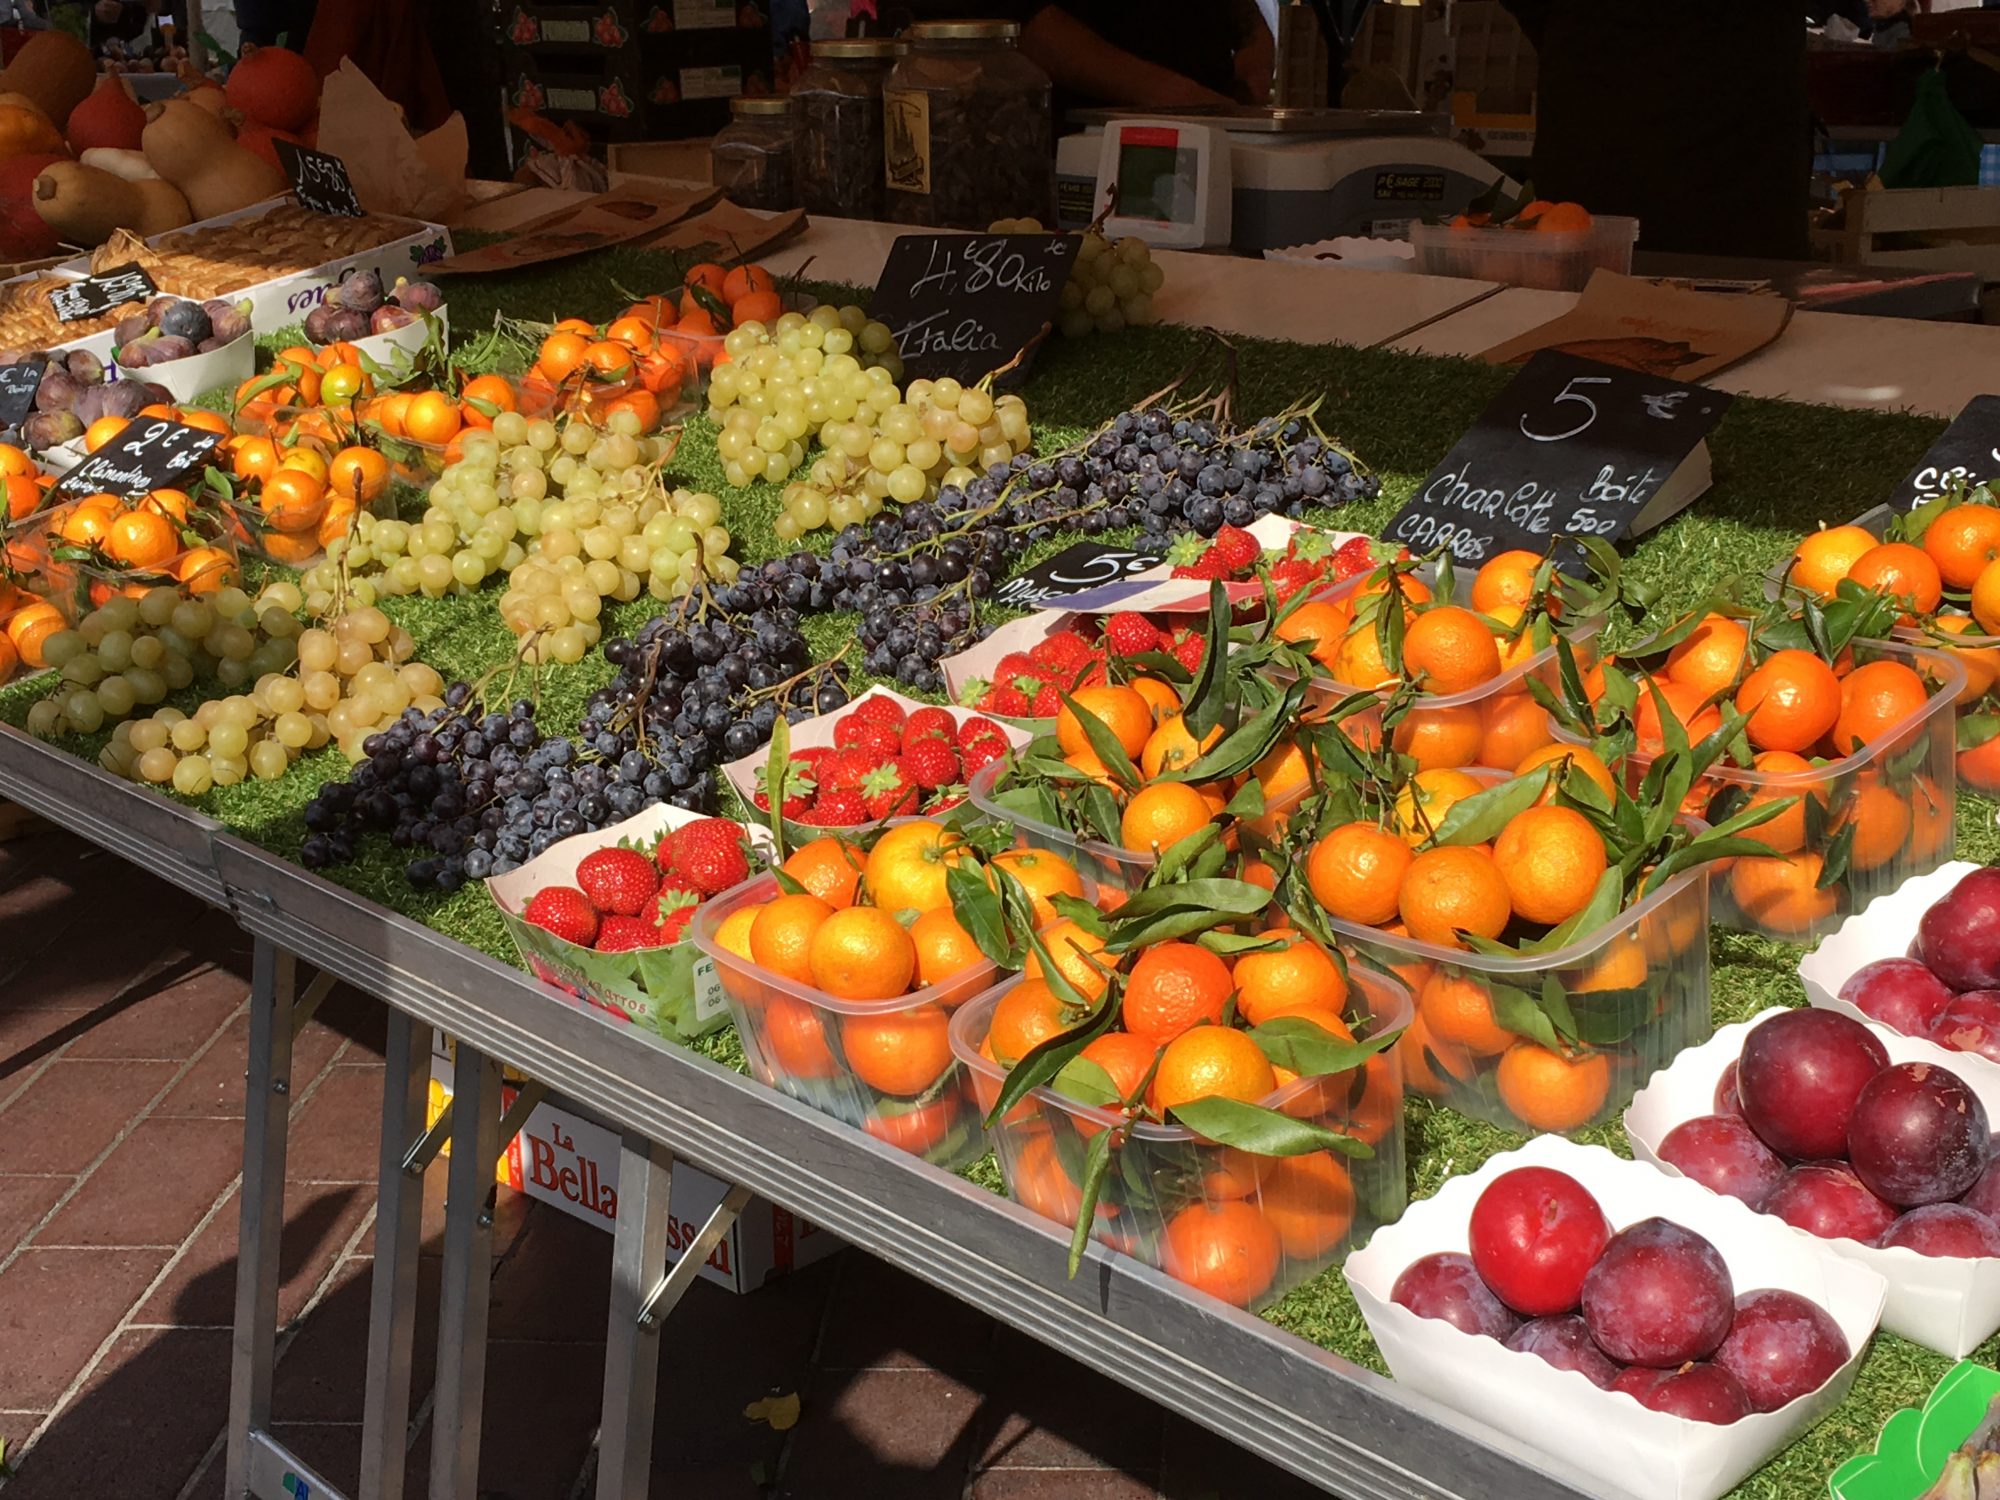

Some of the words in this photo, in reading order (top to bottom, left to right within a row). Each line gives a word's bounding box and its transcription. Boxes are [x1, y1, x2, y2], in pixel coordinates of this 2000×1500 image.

[1520, 376, 1612, 442] 5
[122, 422, 160, 457] 2
[1048, 552, 1139, 584] 5
[551, 1121, 576, 1153] La
[526, 1132, 619, 1220] Bella
